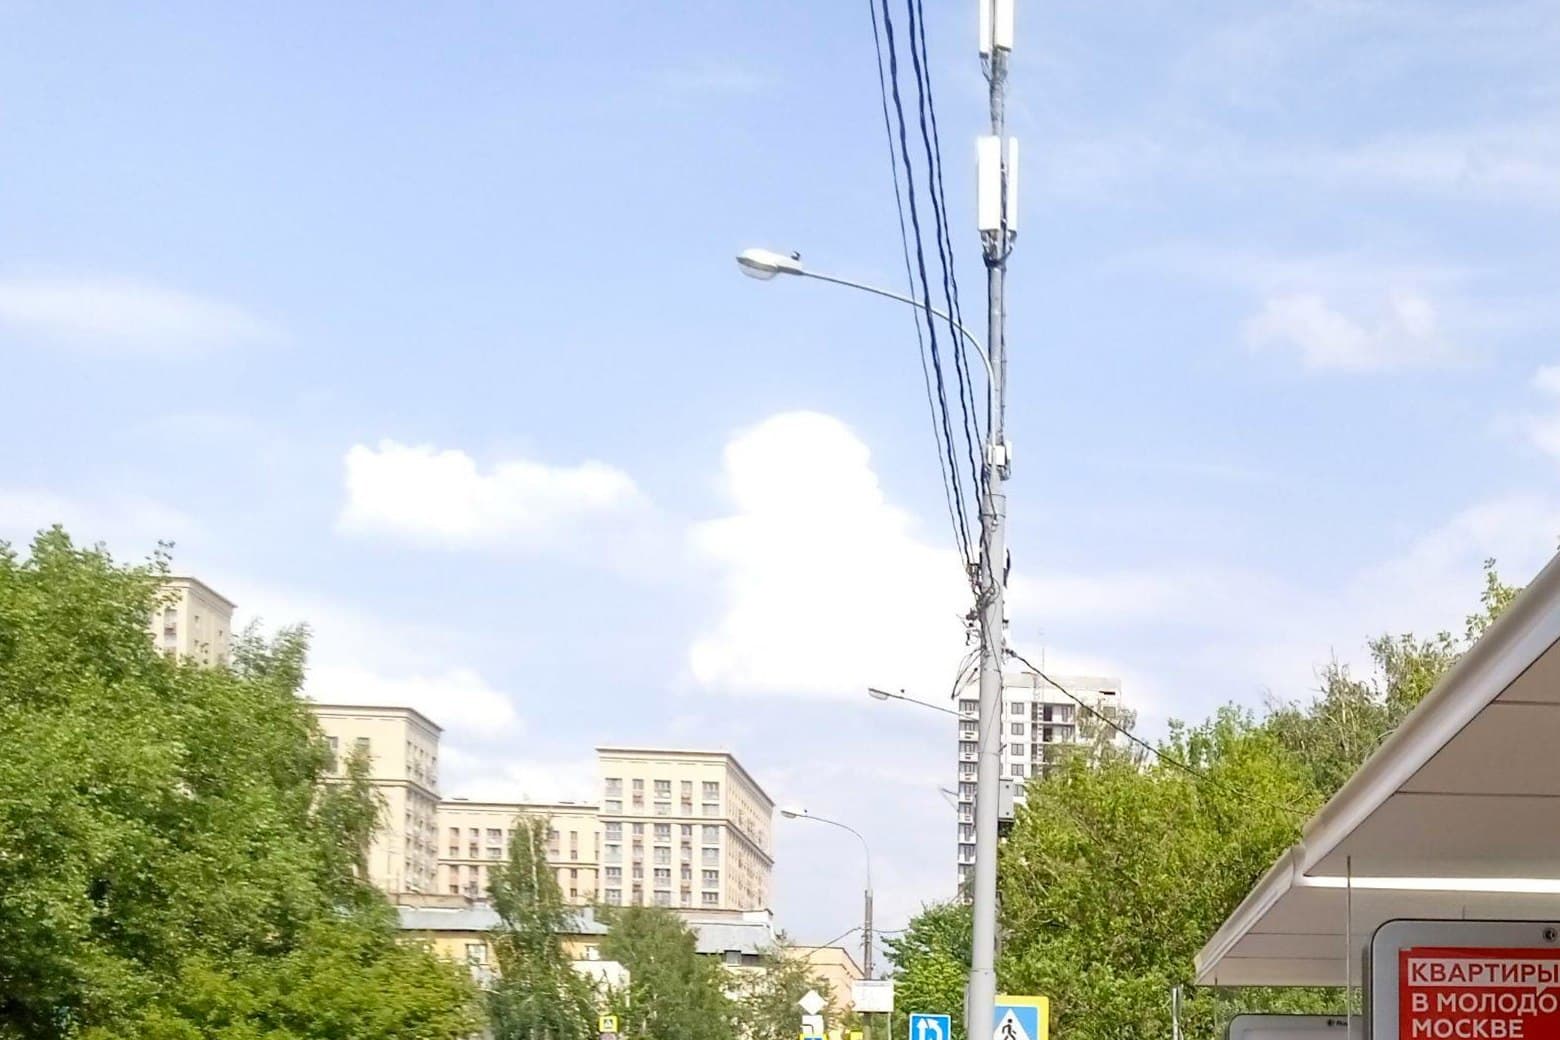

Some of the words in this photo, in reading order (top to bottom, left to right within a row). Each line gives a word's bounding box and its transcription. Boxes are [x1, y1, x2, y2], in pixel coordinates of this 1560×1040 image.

[1411, 962, 1559, 983] КВАРТИРЫ
[1411, 992, 1430, 1013] В
[1411, 1018, 1525, 1039] МОСКВЕ
